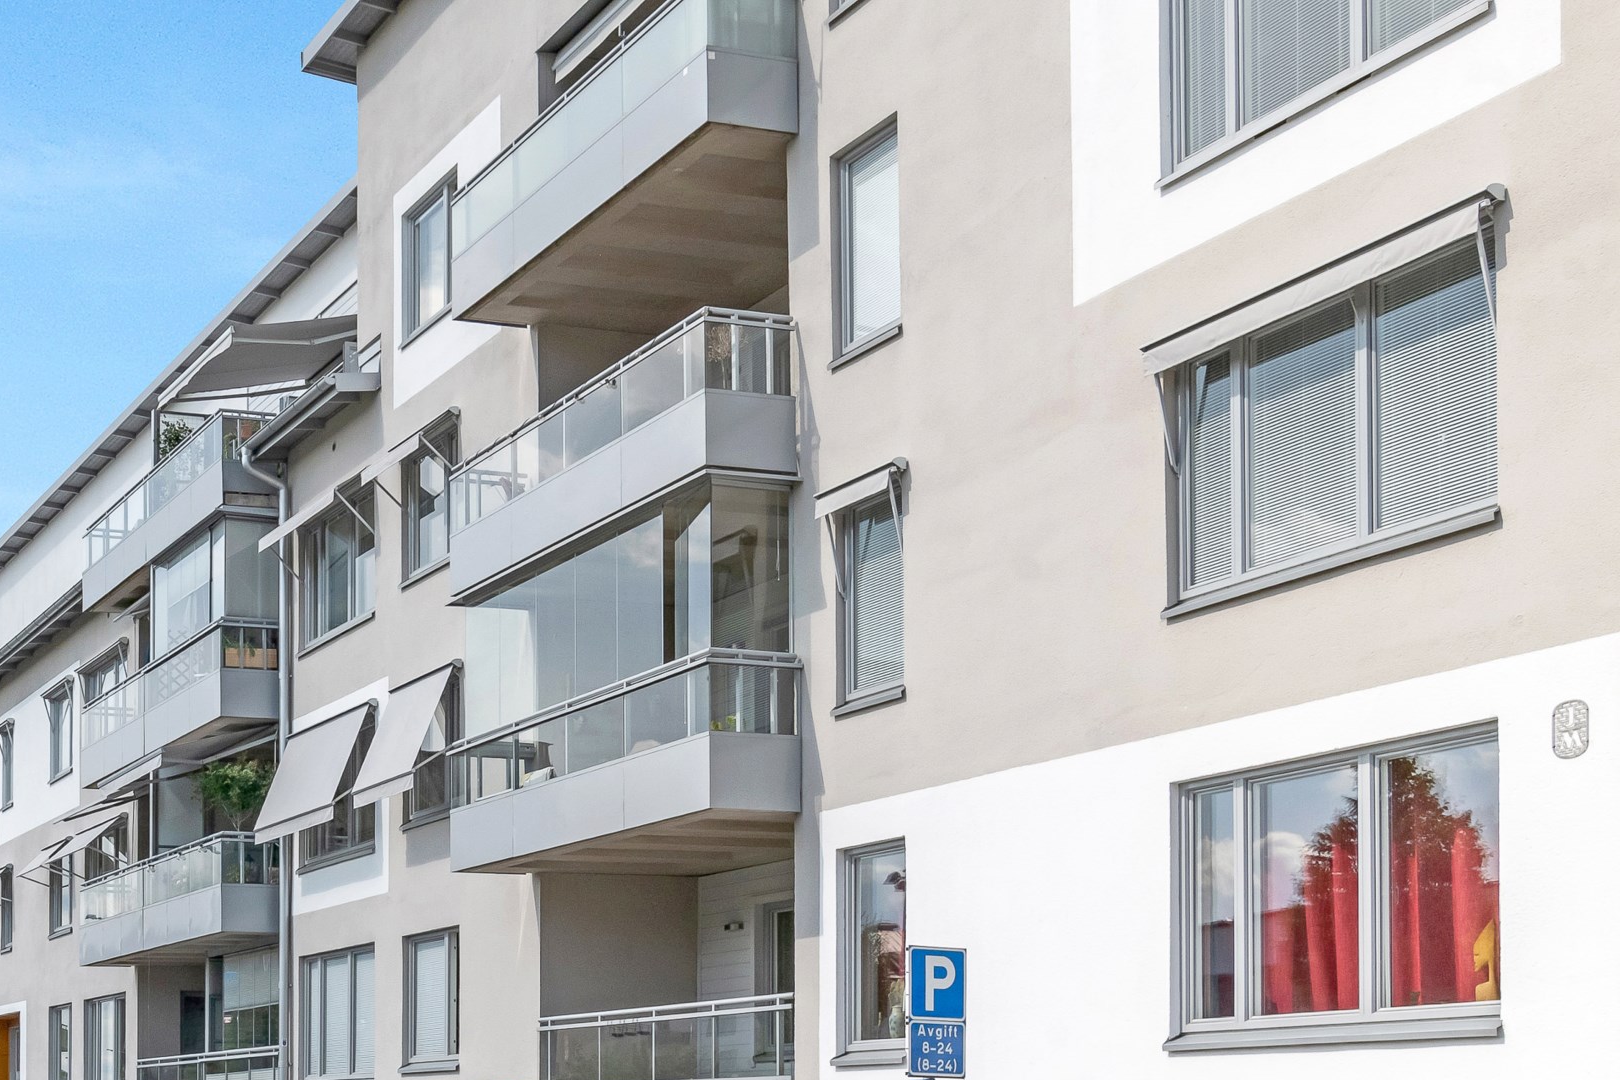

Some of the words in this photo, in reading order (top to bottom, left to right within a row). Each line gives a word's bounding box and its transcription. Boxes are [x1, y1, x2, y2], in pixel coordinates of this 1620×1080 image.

[925, 954, 956, 1012] P
[917, 1024, 958, 1040] Avgift
[922, 1041, 953, 1055] 8-24
[917, 1057, 957, 1073] (8-24)
